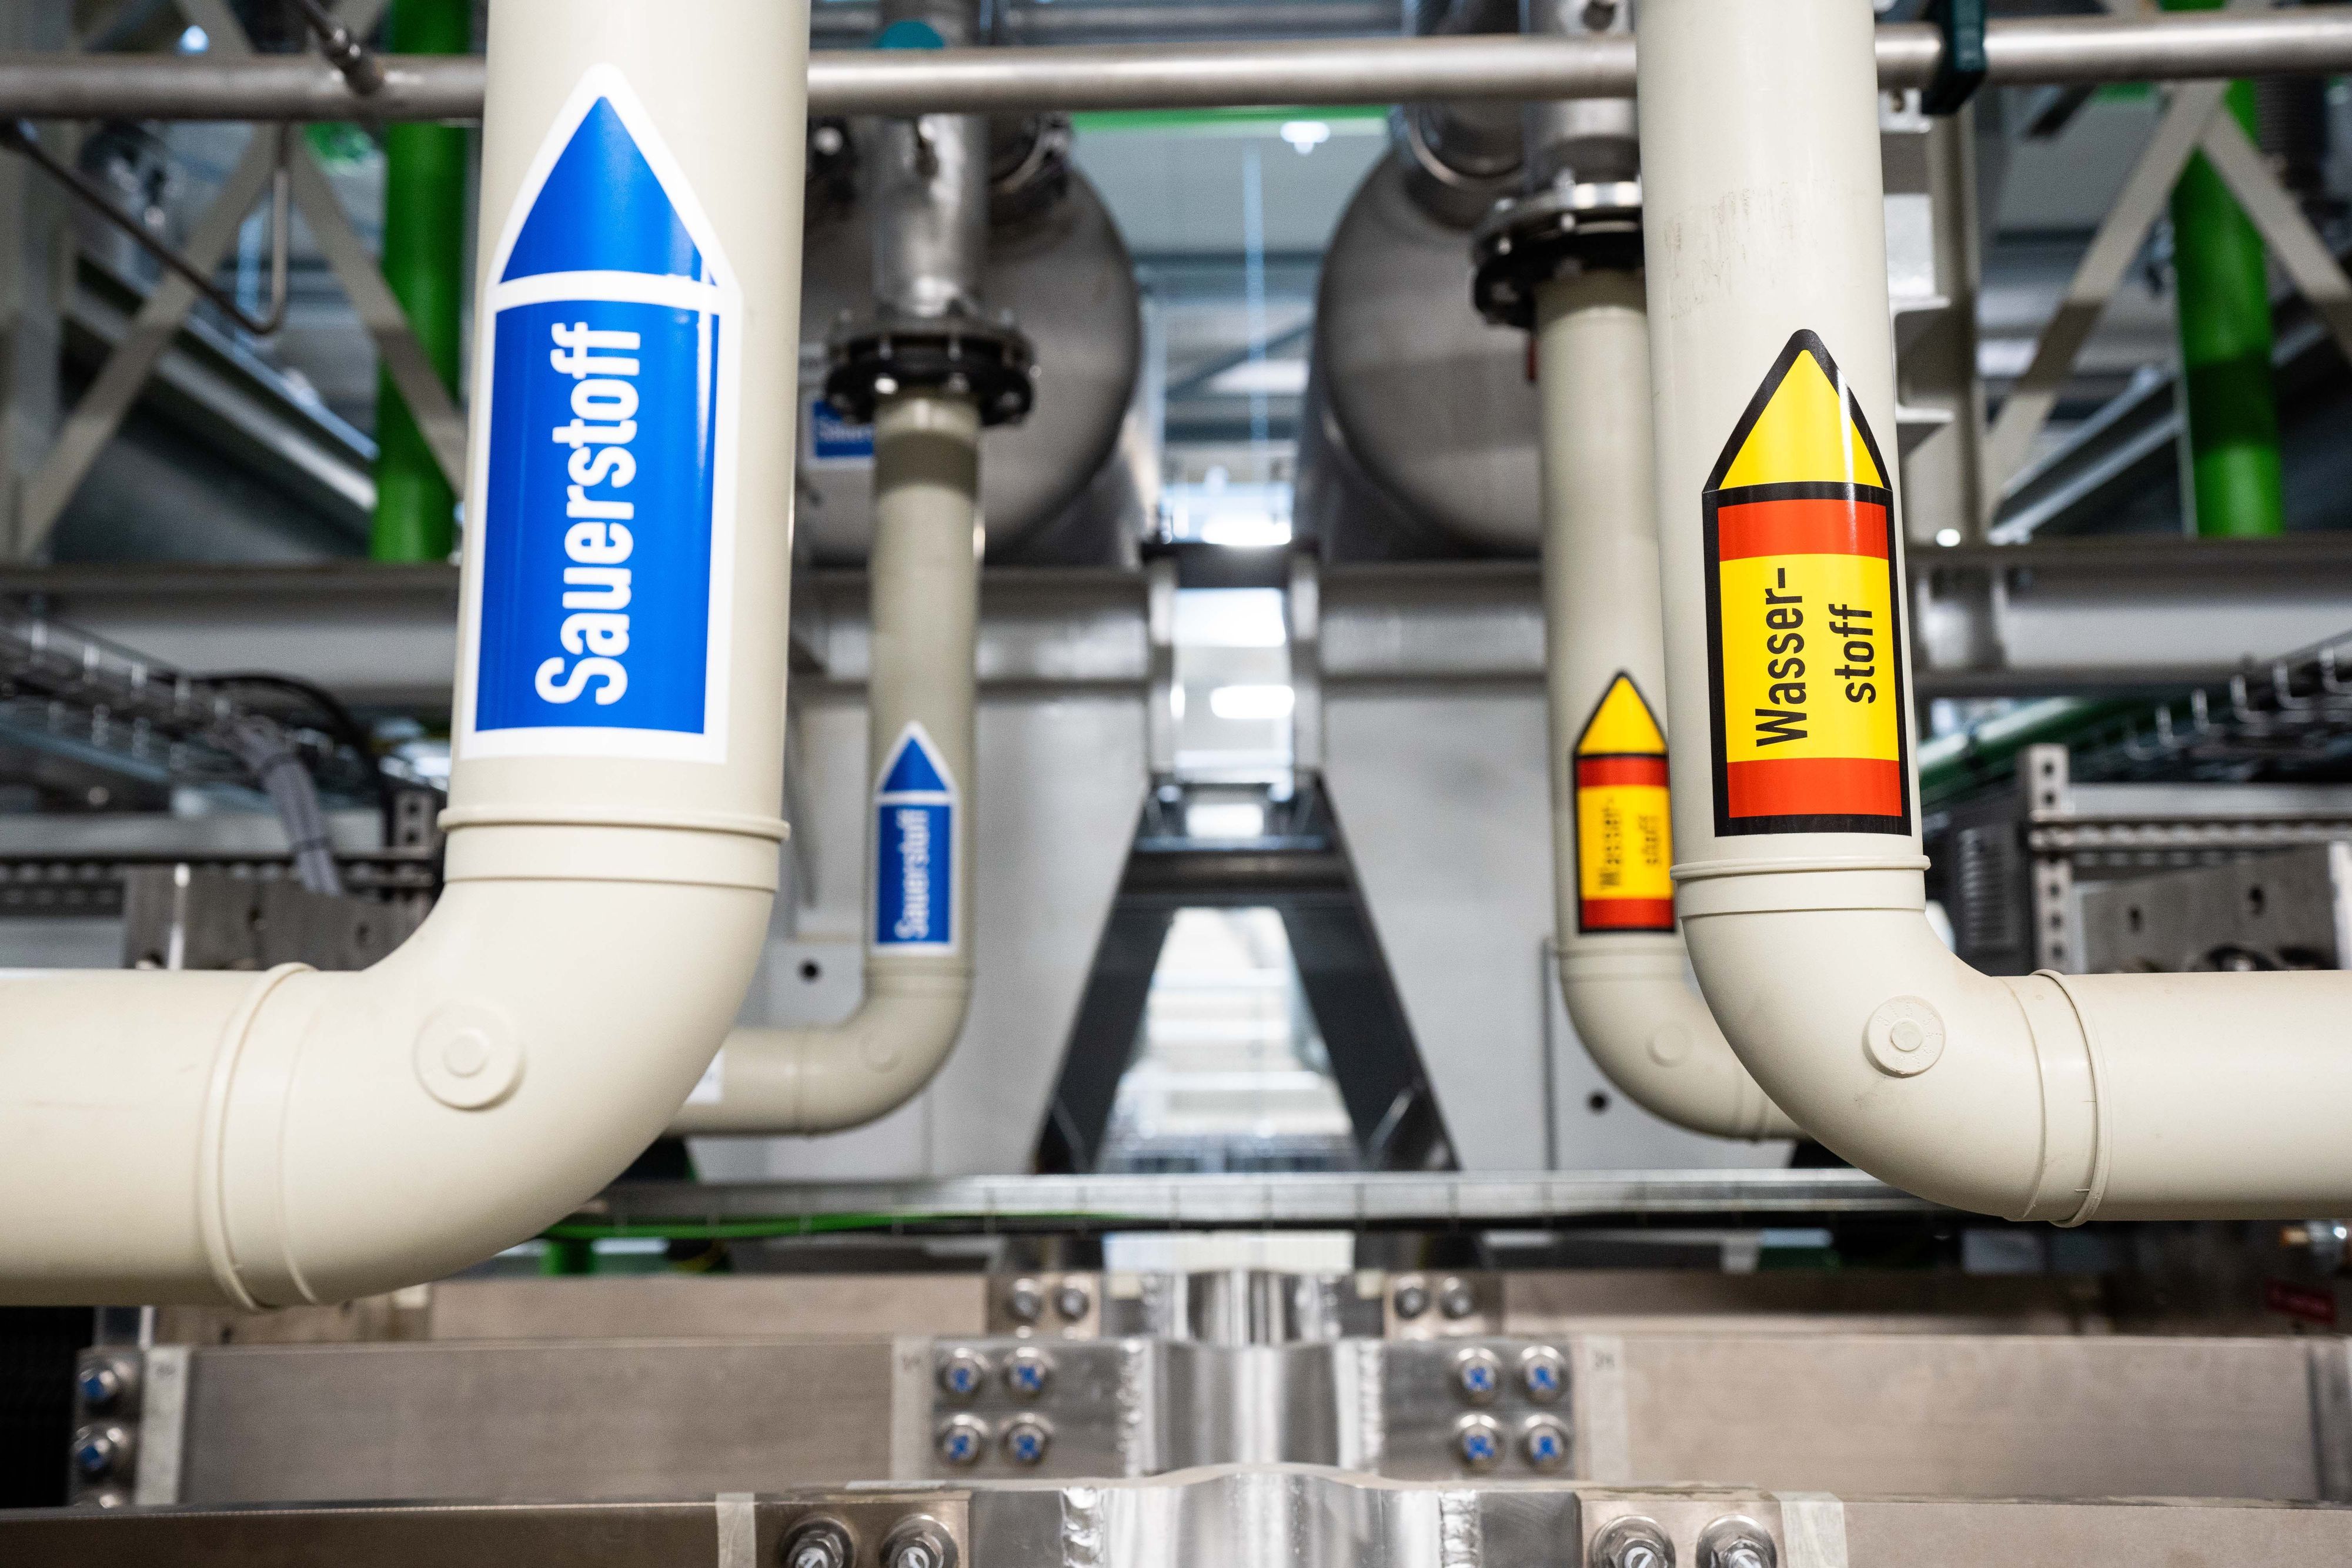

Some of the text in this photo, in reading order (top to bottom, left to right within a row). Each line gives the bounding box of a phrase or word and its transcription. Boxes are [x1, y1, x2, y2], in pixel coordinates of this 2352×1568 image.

[534, 322, 641, 706] Sauerstoff
[1755, 567, 1808, 747] Wasser-
[1828, 603, 1876, 704] stoff
